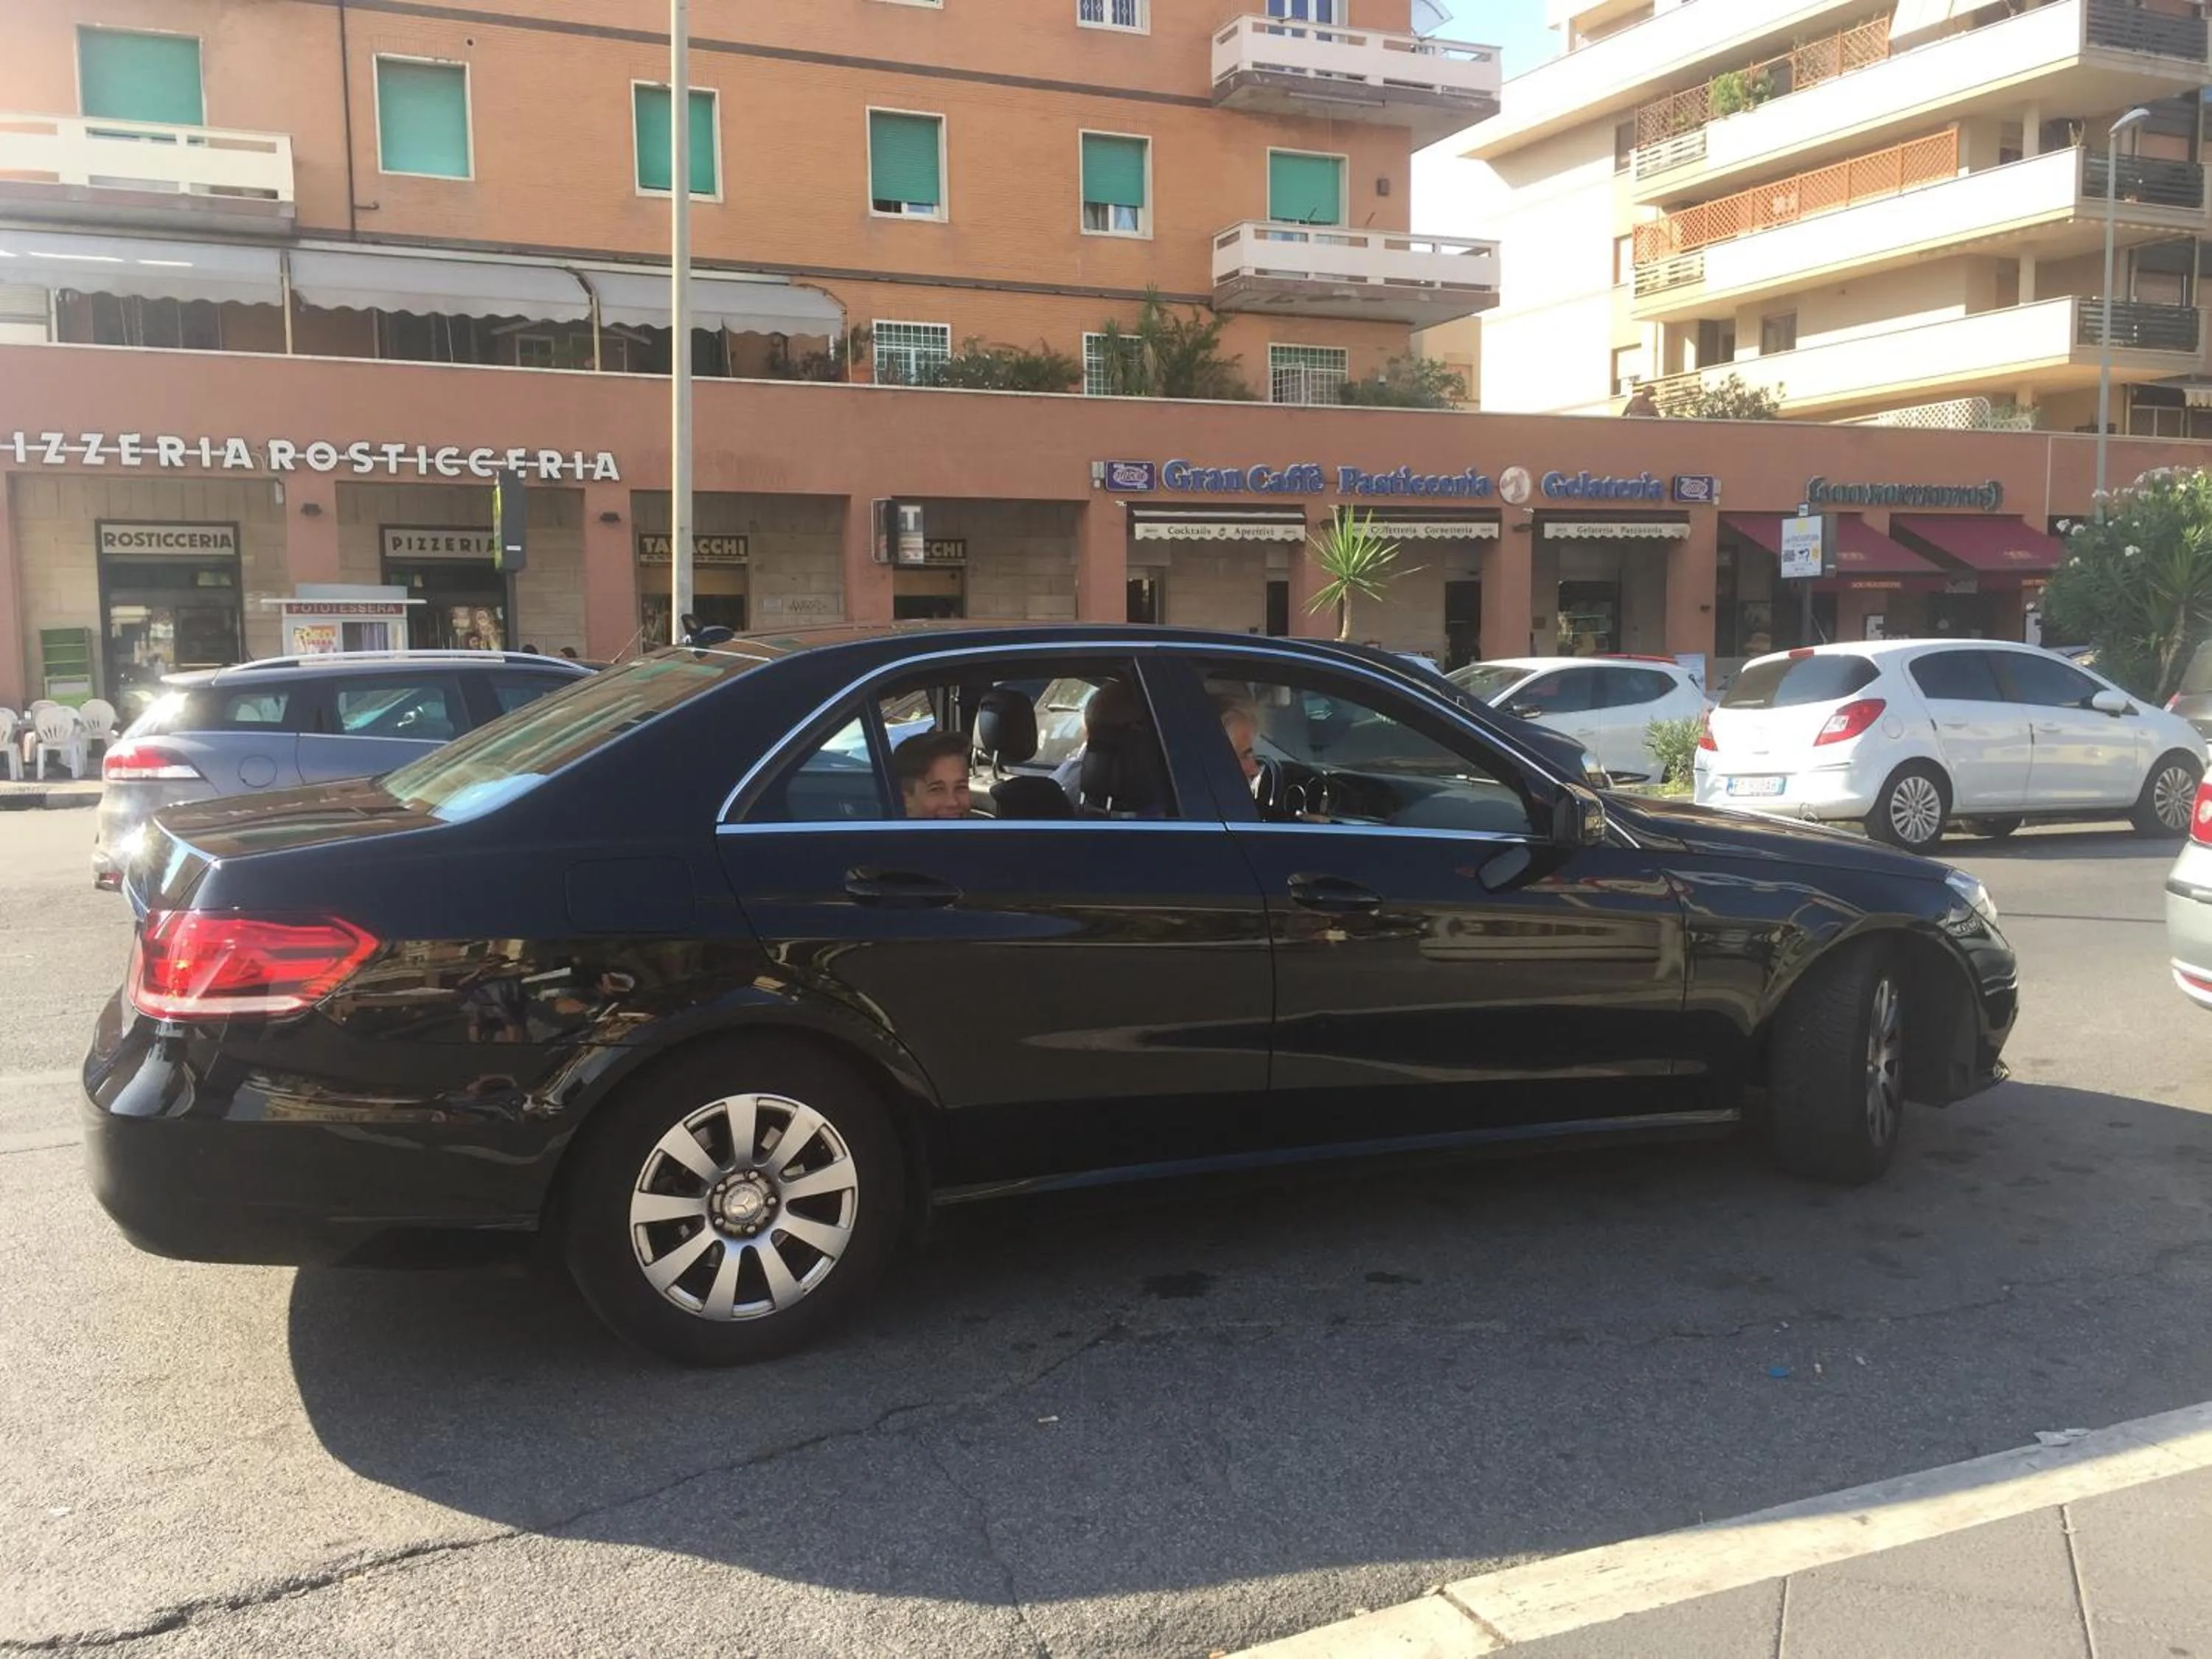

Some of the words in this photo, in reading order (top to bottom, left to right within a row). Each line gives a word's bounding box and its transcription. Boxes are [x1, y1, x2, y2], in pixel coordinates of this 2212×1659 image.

[13, 431, 254, 470] IZZERIA
[268, 439, 620, 481] ROSTICCERIA
[1162, 459, 1244, 493] Gran
[1337, 465, 1492, 498] Pasticceria
[1541, 470, 1663, 500] Gelateria
[1167, 525, 1211, 535] Cocktails
[103, 531, 232, 549] ROSTICCERIA
[392, 535, 501, 552] PIZZERIA
[644, 537, 746, 555] TACCHI
[292, 603, 397, 613] FOTOTESSERA
